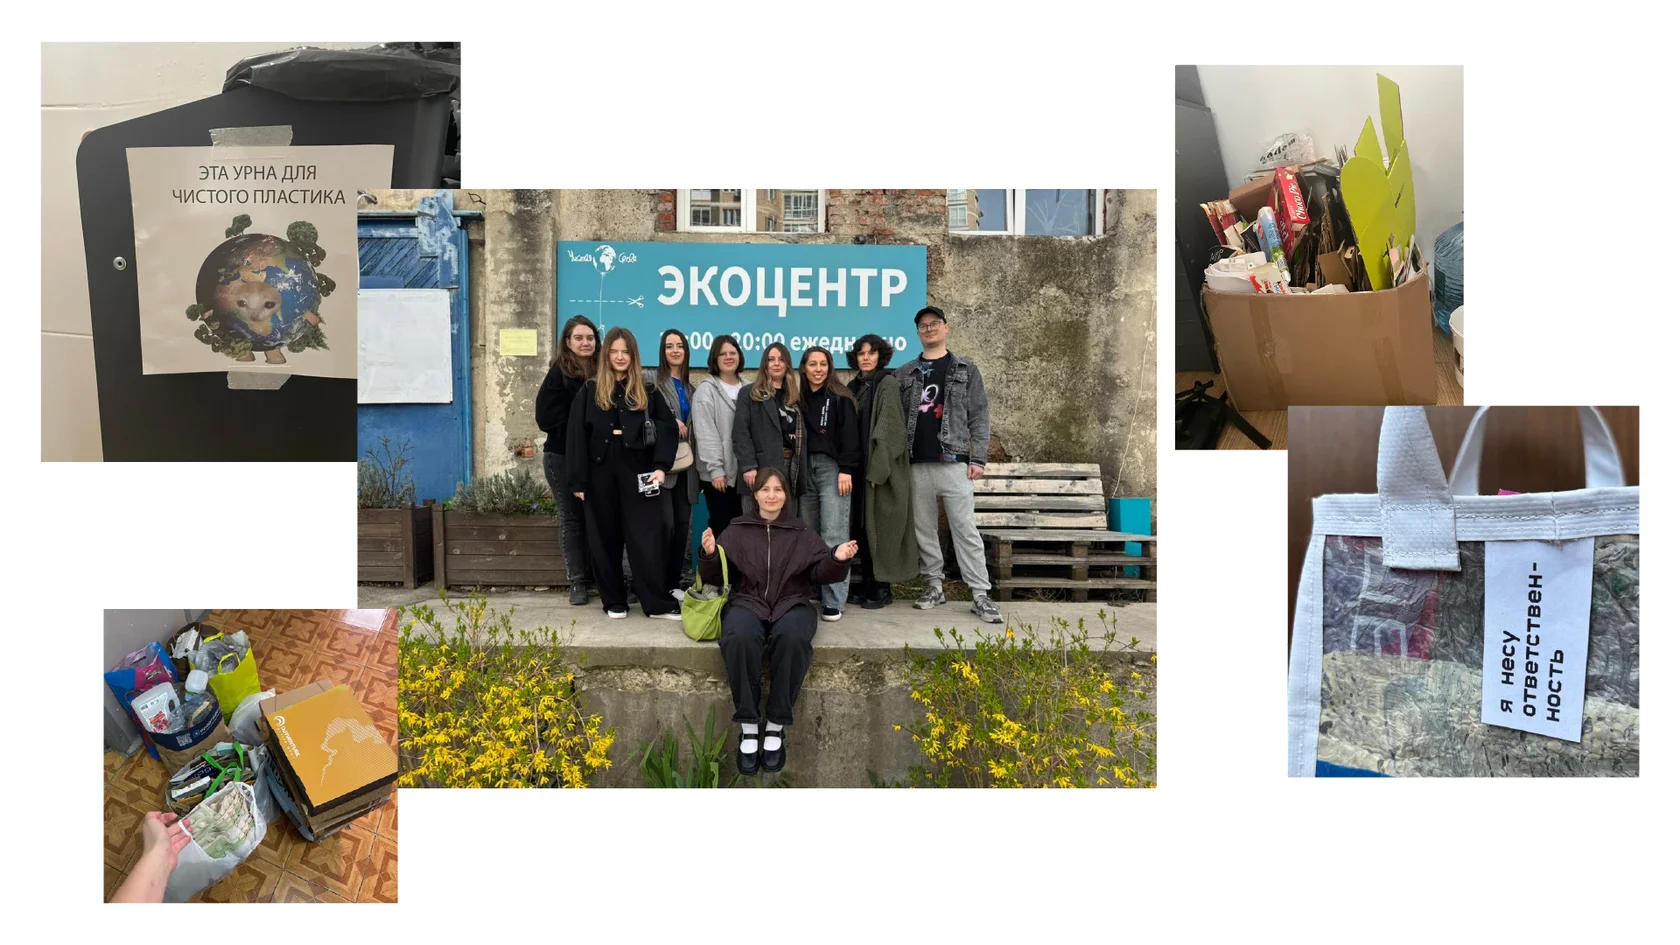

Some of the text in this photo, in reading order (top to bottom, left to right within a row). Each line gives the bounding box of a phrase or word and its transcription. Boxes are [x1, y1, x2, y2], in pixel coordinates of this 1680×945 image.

[199, 165, 316, 183] ЭТА УРНА ДЛЯ
[1288, 182, 1299, 197] Pie
[172, 189, 346, 205] ЧИСТОГО ПЛАСТИКА
[1294, 195, 1307, 220] Choco
[657, 265, 908, 318] ЭКОЦЕНТР
[1501, 630, 1521, 686] несу
[1522, 562, 1544, 718] ответствен-
[1546, 649, 1565, 723] ность
